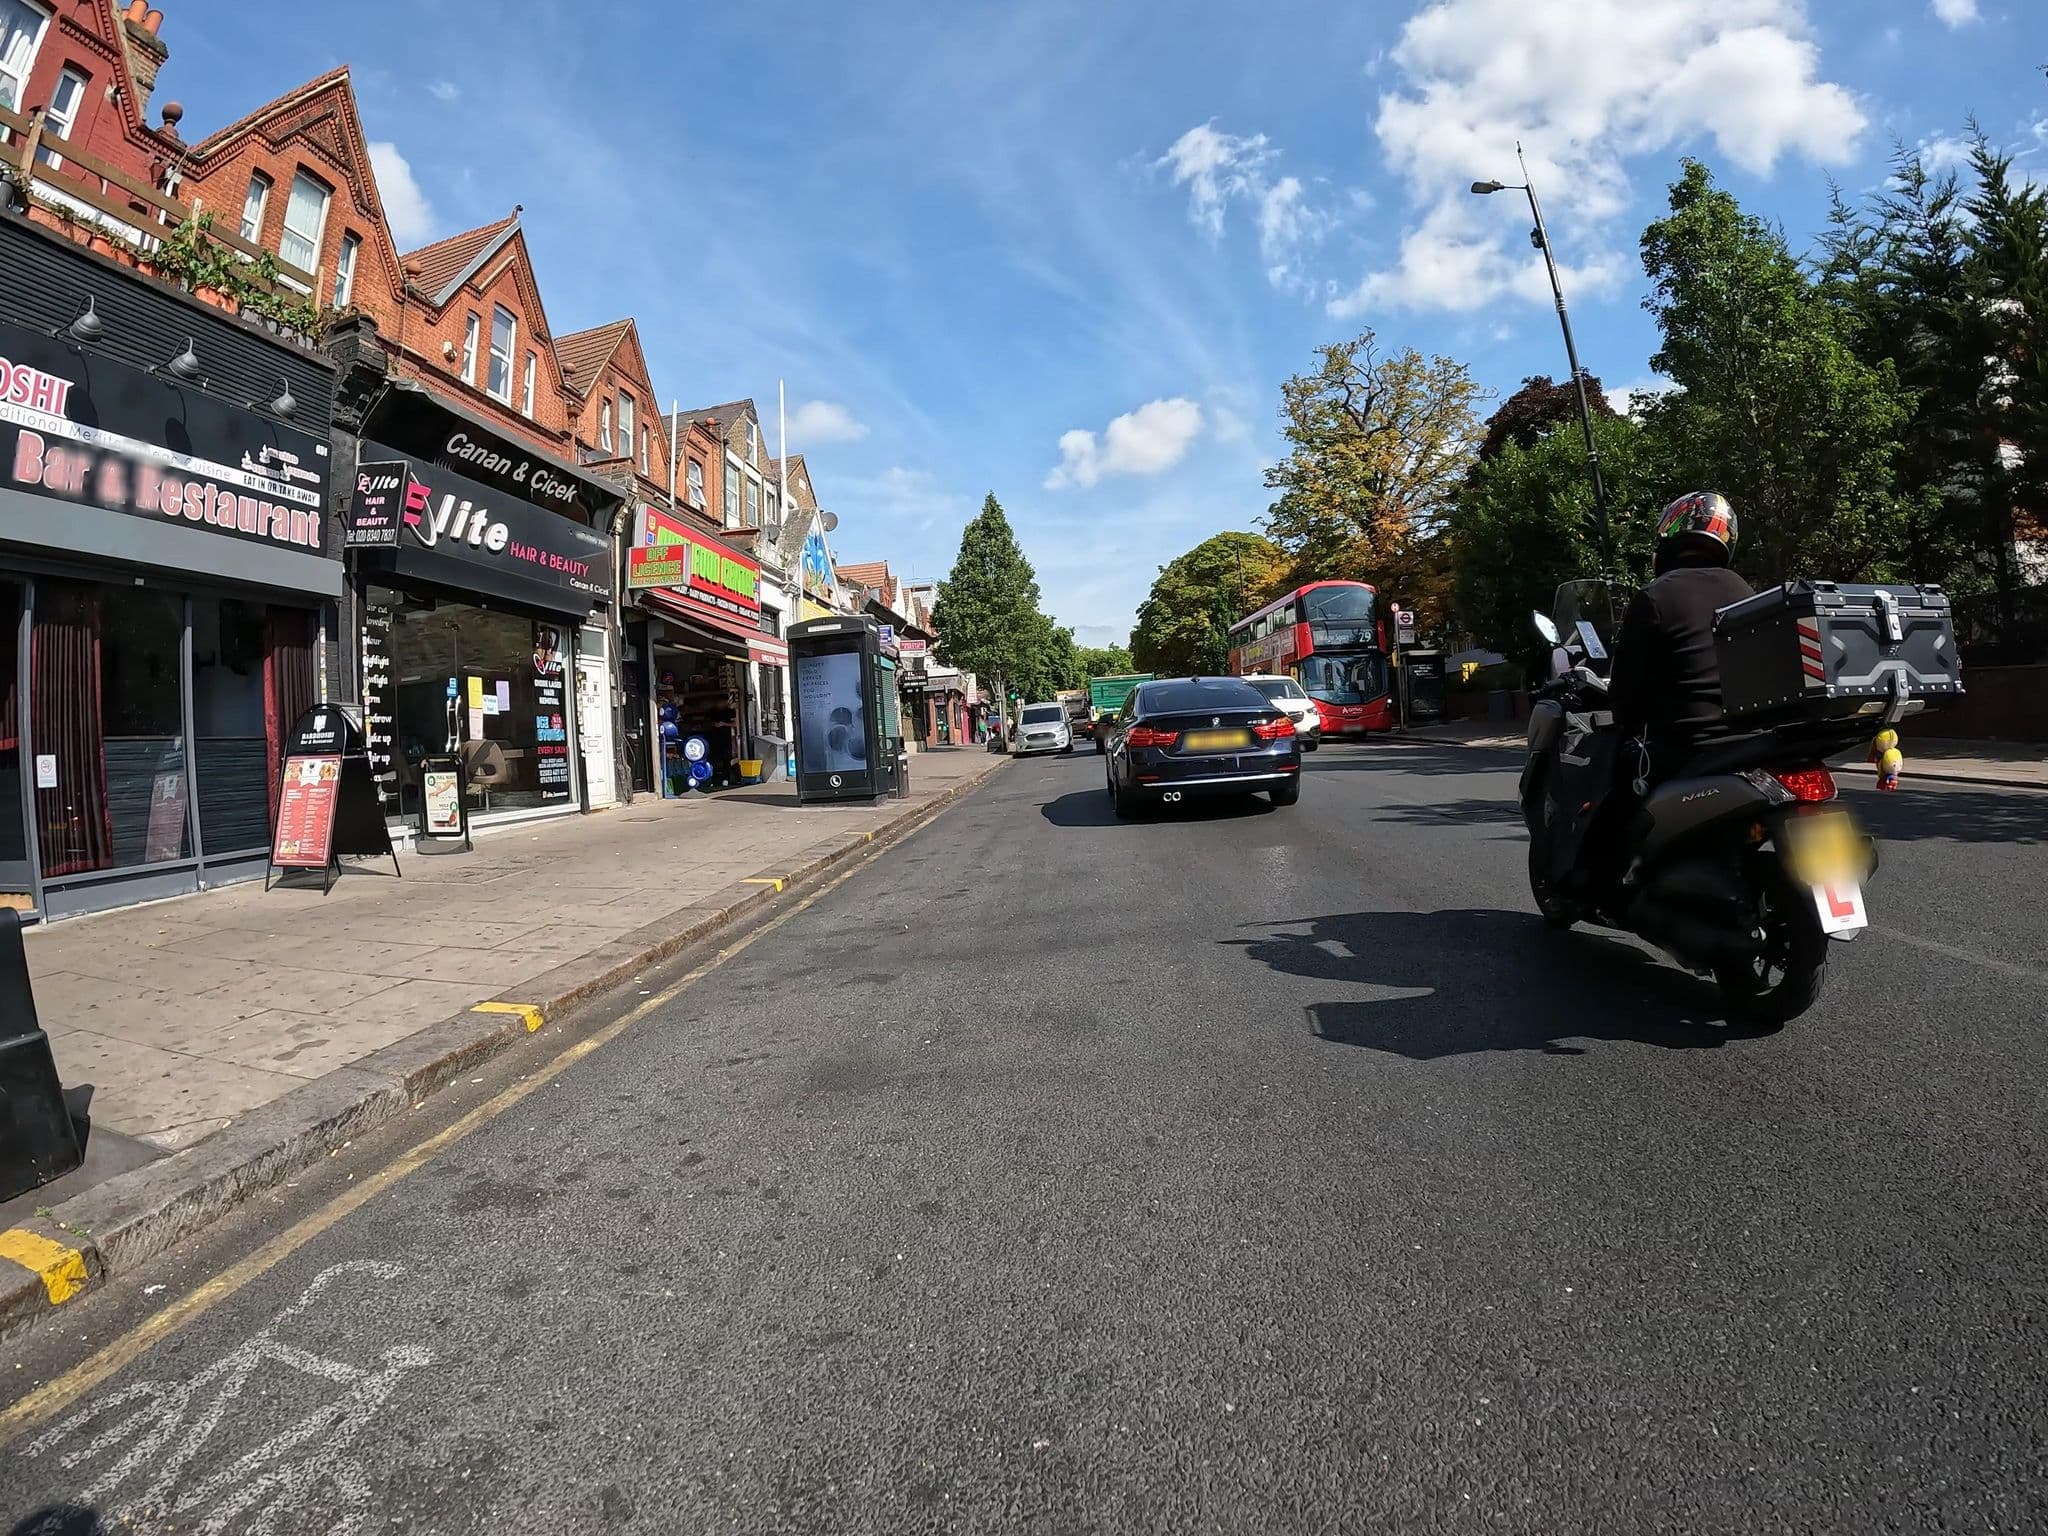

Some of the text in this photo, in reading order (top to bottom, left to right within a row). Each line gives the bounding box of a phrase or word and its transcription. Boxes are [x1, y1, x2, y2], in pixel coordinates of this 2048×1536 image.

[15, 429, 90, 496] Bar
[446, 433, 511, 475] Canan
[512, 461, 529, 482] &
[243, 474, 317, 504] EAT IN OR TAKE AWAY
[357, 473, 400, 494] Elite
[365, 497, 385, 505] HAIR
[370, 507, 376, 515] &
[403, 472, 509, 551] Elite
[356, 517, 389, 527] BEAUTY
[510, 541, 589, 577] HAIR & BEAUTY
[646, 547, 669, 562] OFF
[633, 560, 682, 577] LICENCE
[1359, 631, 1372, 643] 29
[1823, 880, 1855, 917] L
